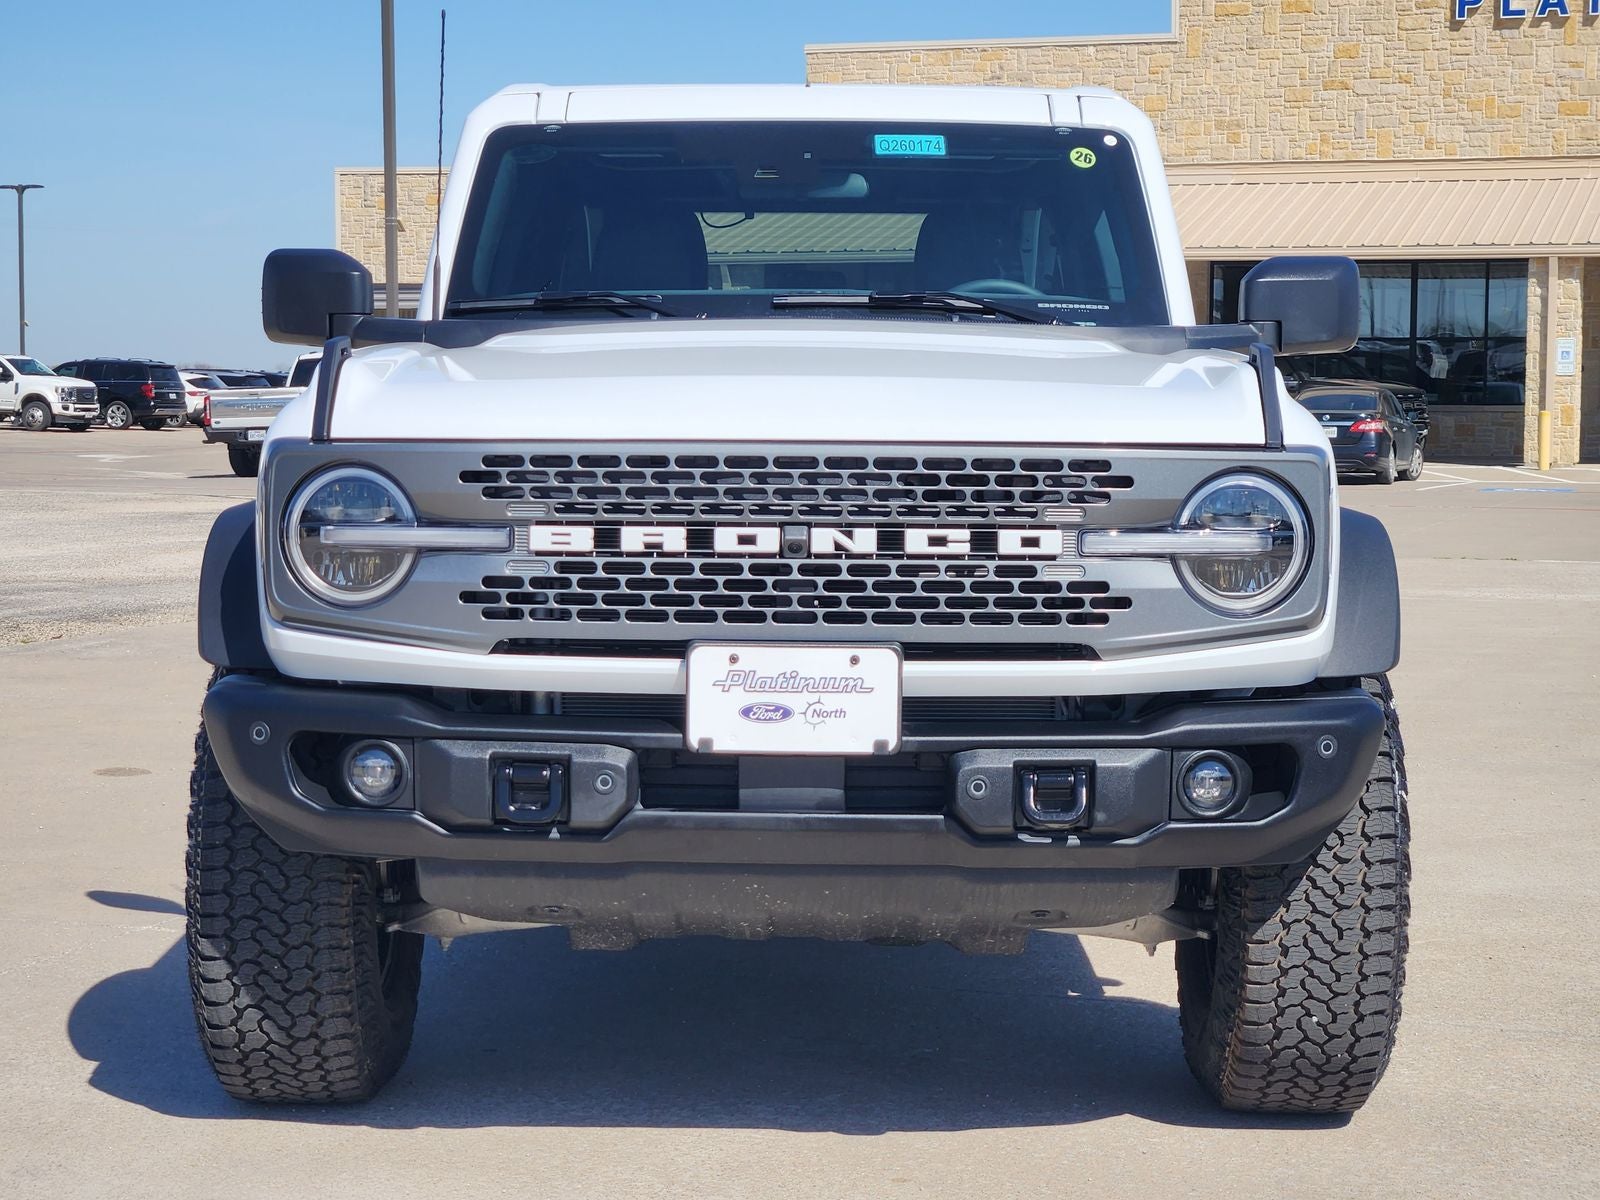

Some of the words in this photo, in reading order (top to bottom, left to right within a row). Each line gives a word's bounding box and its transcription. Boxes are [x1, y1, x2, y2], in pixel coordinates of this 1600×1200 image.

[879, 139, 942, 152] Q260174
[1074, 150, 1093, 164] 26
[529, 525, 1063, 555] BRONCO
[712, 670, 874, 693] Platinum
[749, 704, 784, 721] Ford
[811, 707, 847, 720] North
